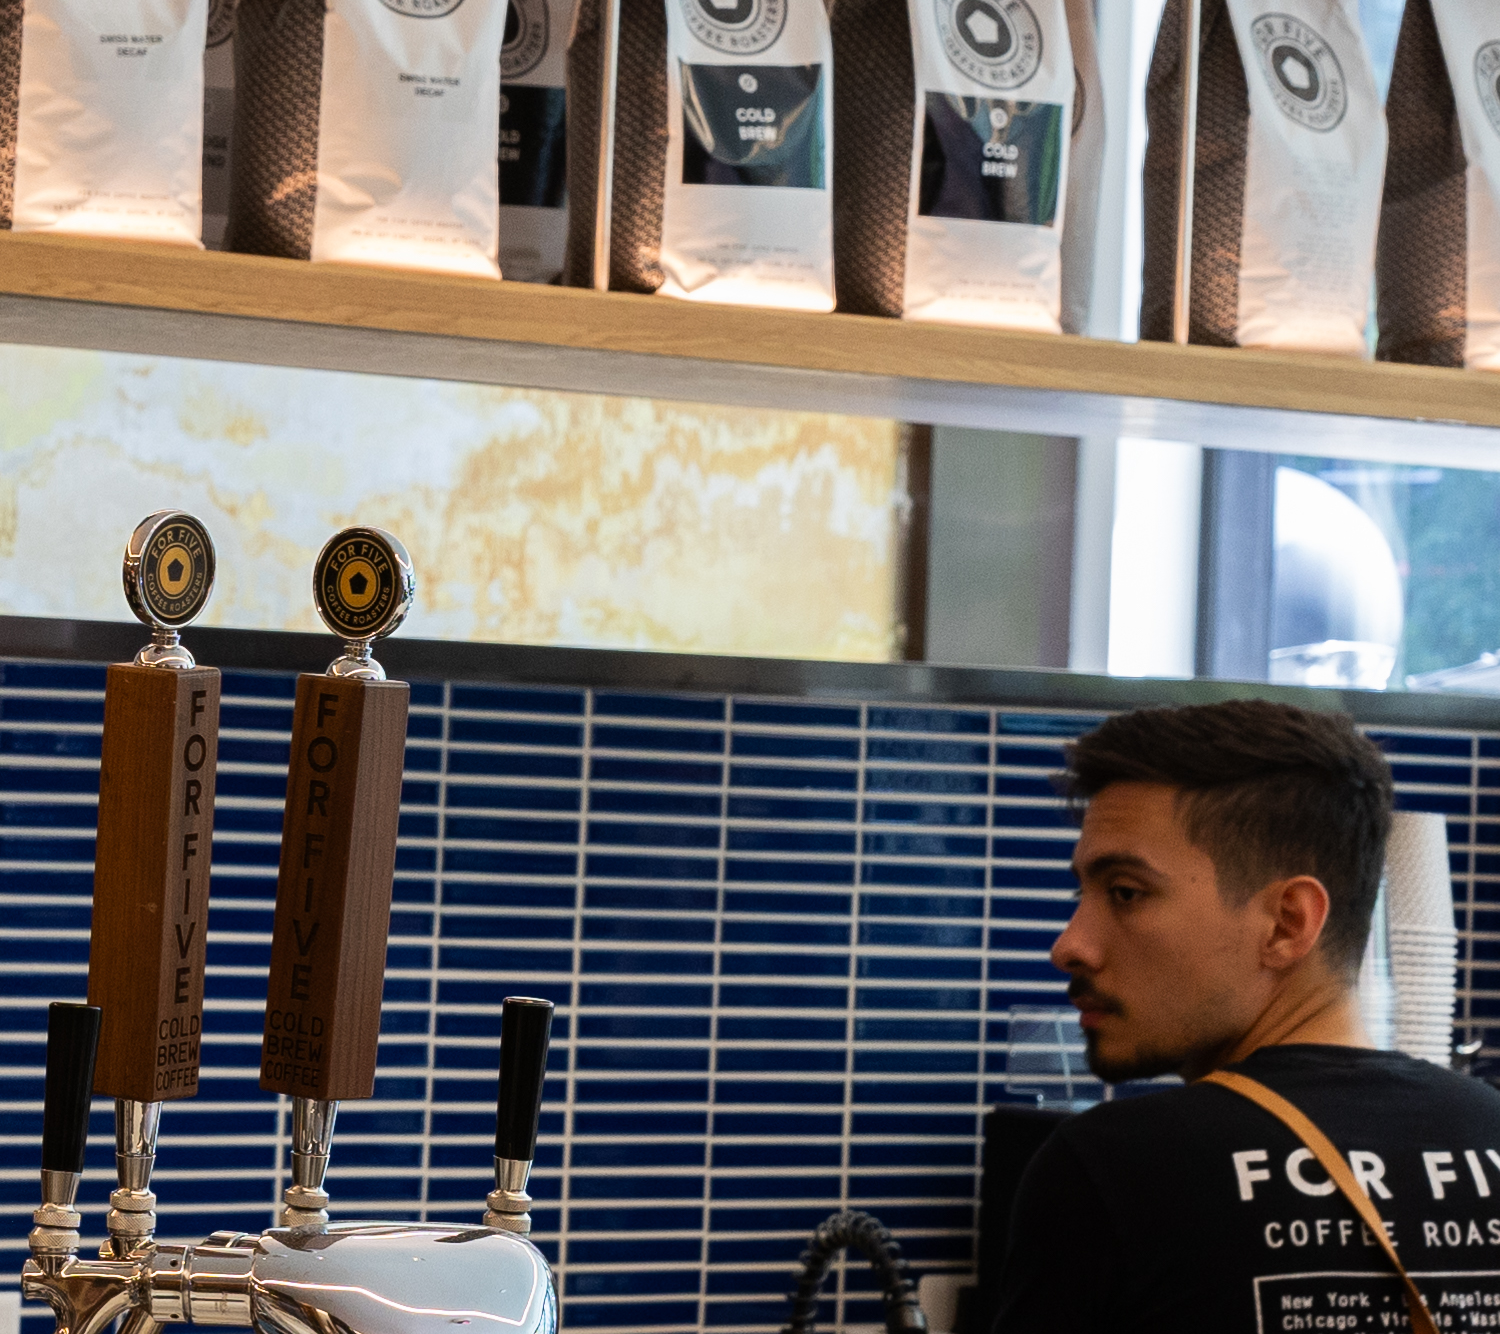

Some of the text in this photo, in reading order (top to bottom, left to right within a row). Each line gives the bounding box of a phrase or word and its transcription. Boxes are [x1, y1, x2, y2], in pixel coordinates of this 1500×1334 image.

[331, 544, 388, 574] FOR FIVE
[327, 585, 391, 624] COFFEE ROASTERS
[174, 689, 207, 1004] FOR FIVE
[158, 1014, 200, 1041] COLD
[156, 1040, 199, 1067] BREW
[156, 1066, 198, 1093] COFFEE
[1232, 1148, 1394, 1201] FOR
[1281, 1292, 1371, 1311] New York
[1282, 1313, 1358, 1331] Chicago
